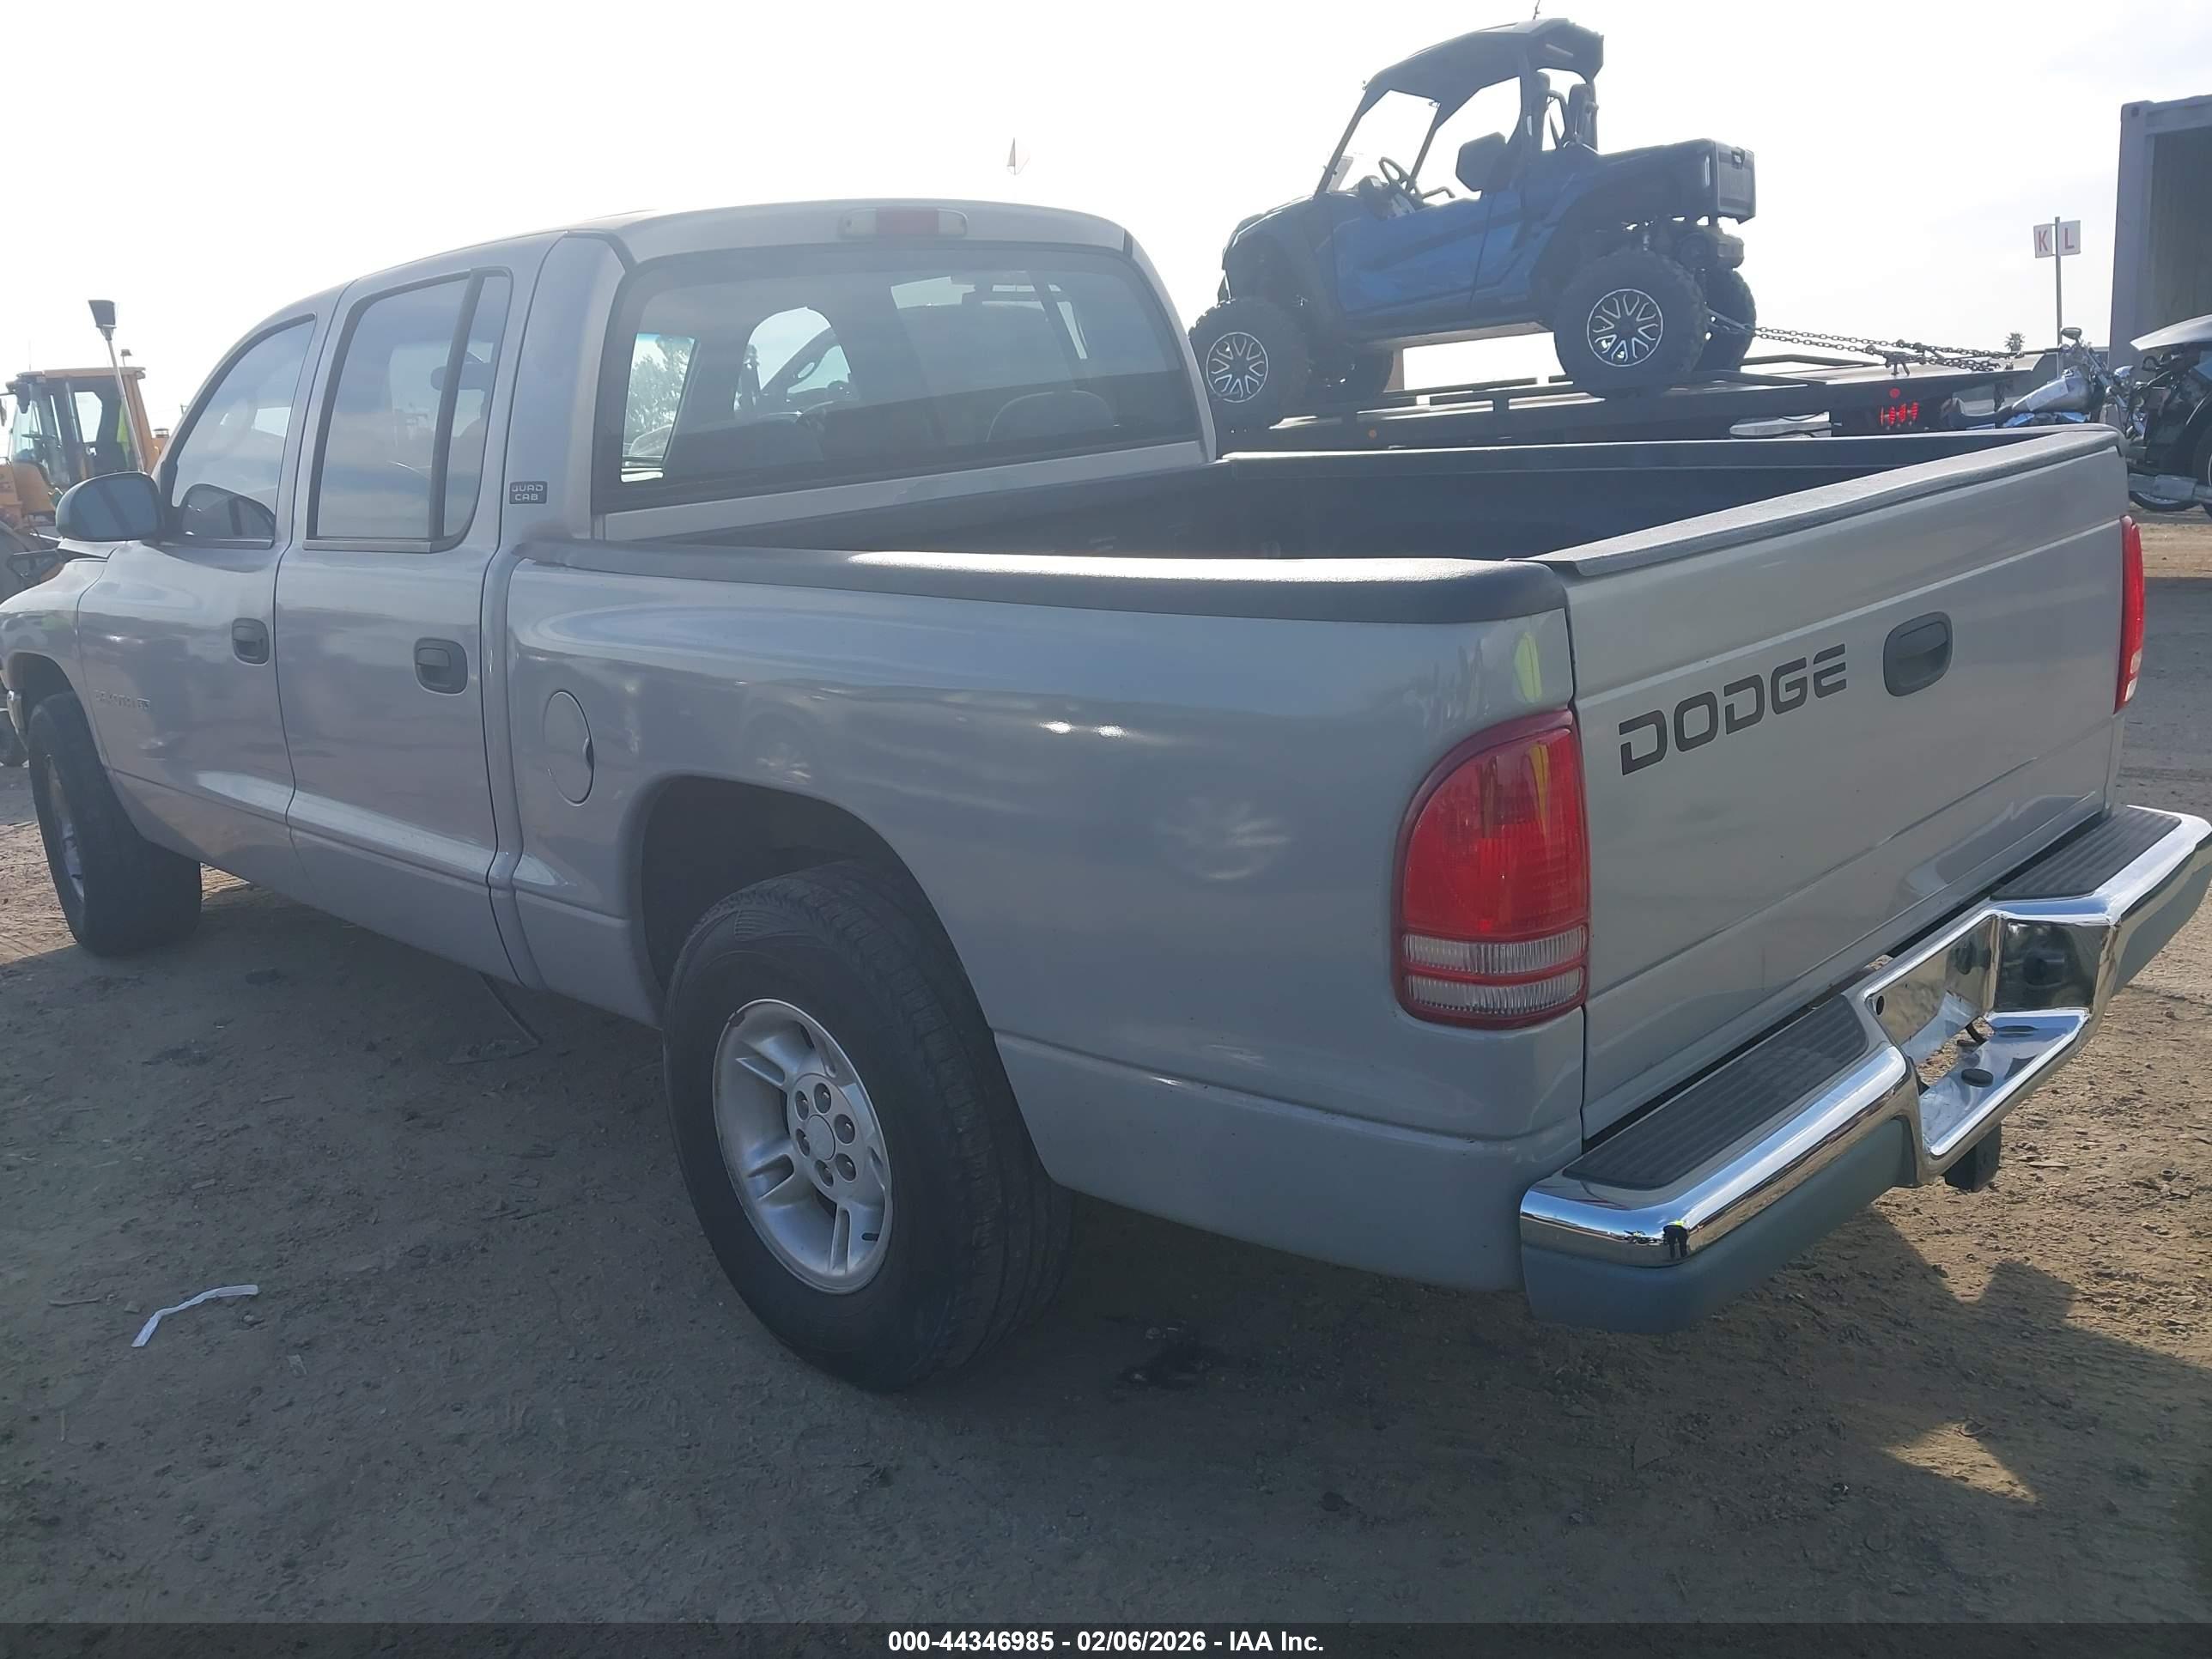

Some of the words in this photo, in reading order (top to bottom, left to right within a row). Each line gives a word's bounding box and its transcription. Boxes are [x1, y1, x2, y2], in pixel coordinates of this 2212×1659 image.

[2038, 229, 2048, 252] K
[2064, 228, 2075, 250] L
[514, 493, 538, 501] CAB
[1619, 643, 1847, 776] DODGE
